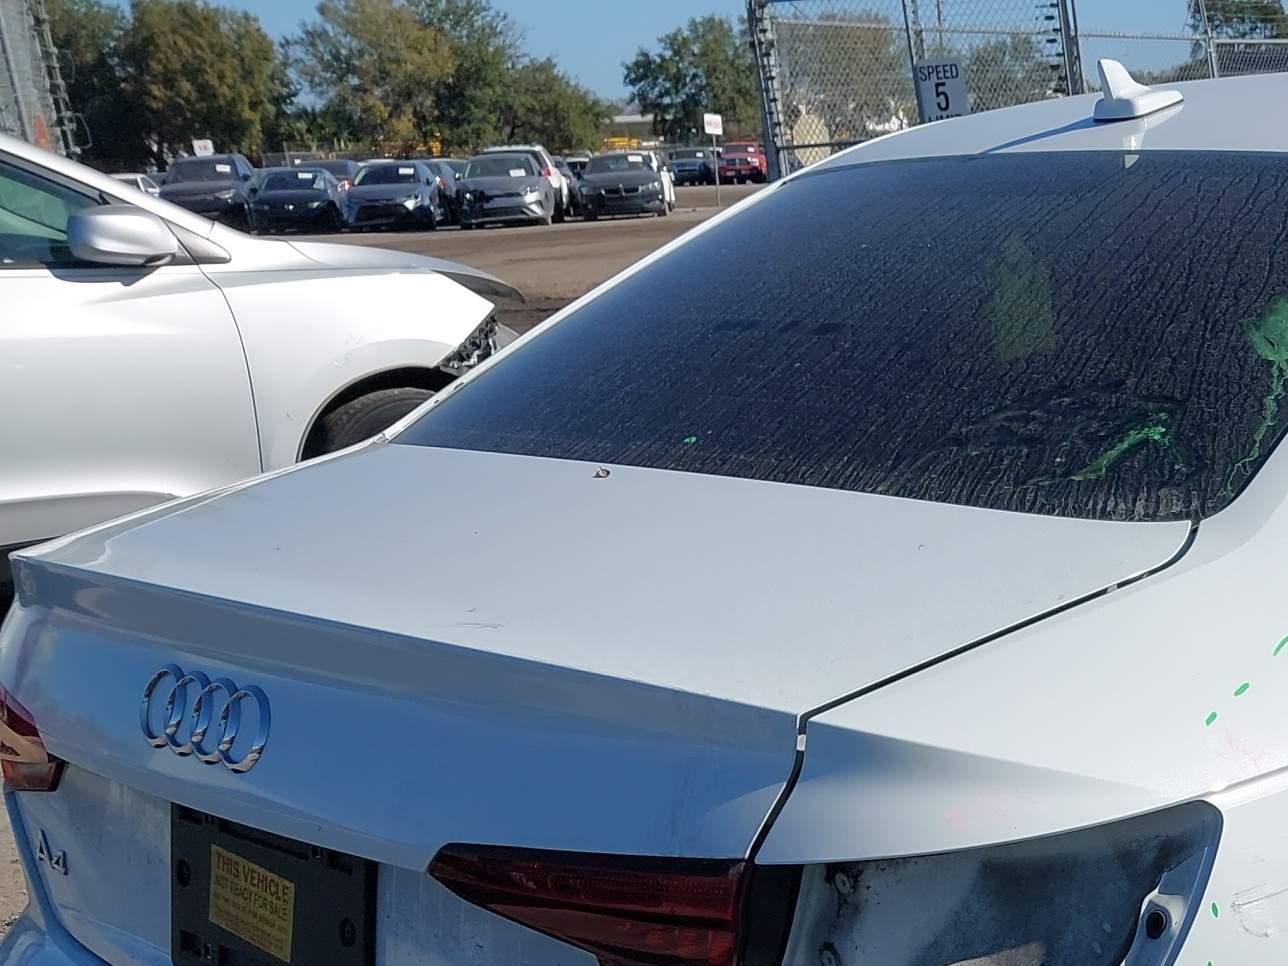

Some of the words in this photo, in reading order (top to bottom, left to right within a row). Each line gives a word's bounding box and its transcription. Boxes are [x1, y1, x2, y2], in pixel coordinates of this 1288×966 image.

[919, 63, 959, 81] SPEED
[934, 81, 950, 112] 5
[37, 828, 69, 876] A4
[215, 851, 240, 879] THIS
[243, 865, 289, 904] VEHICLE
[270, 900, 288, 922] SALE
